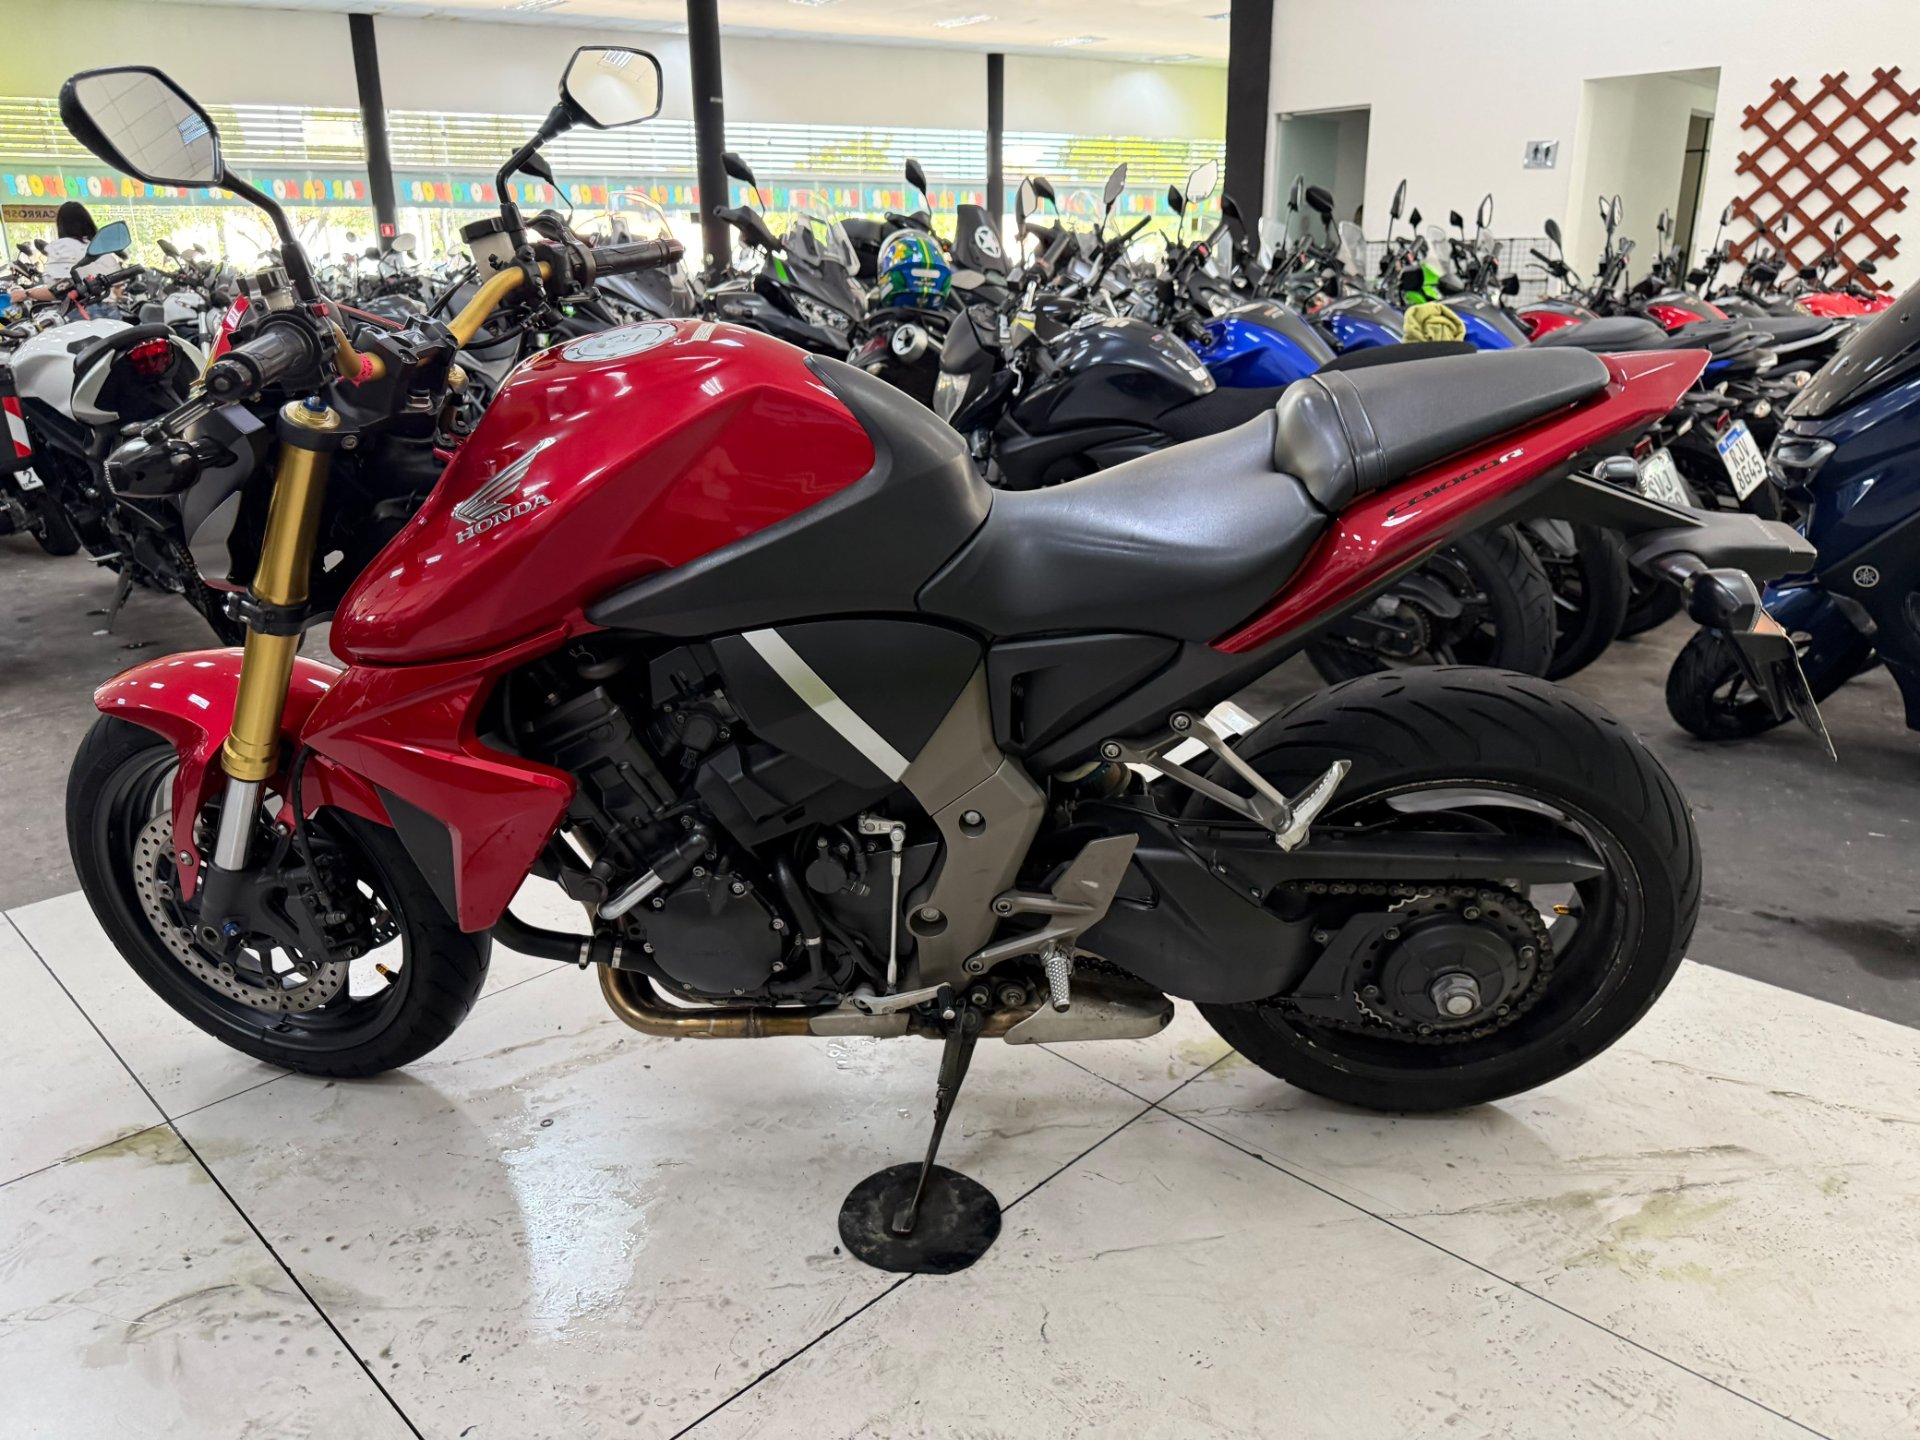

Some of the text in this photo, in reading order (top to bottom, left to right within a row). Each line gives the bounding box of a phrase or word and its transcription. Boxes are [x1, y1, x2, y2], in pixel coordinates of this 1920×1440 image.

[1729, 437, 1750, 469] RJV
[1736, 454, 1763, 491] 8G45
[456, 494, 552, 544] HONDA
